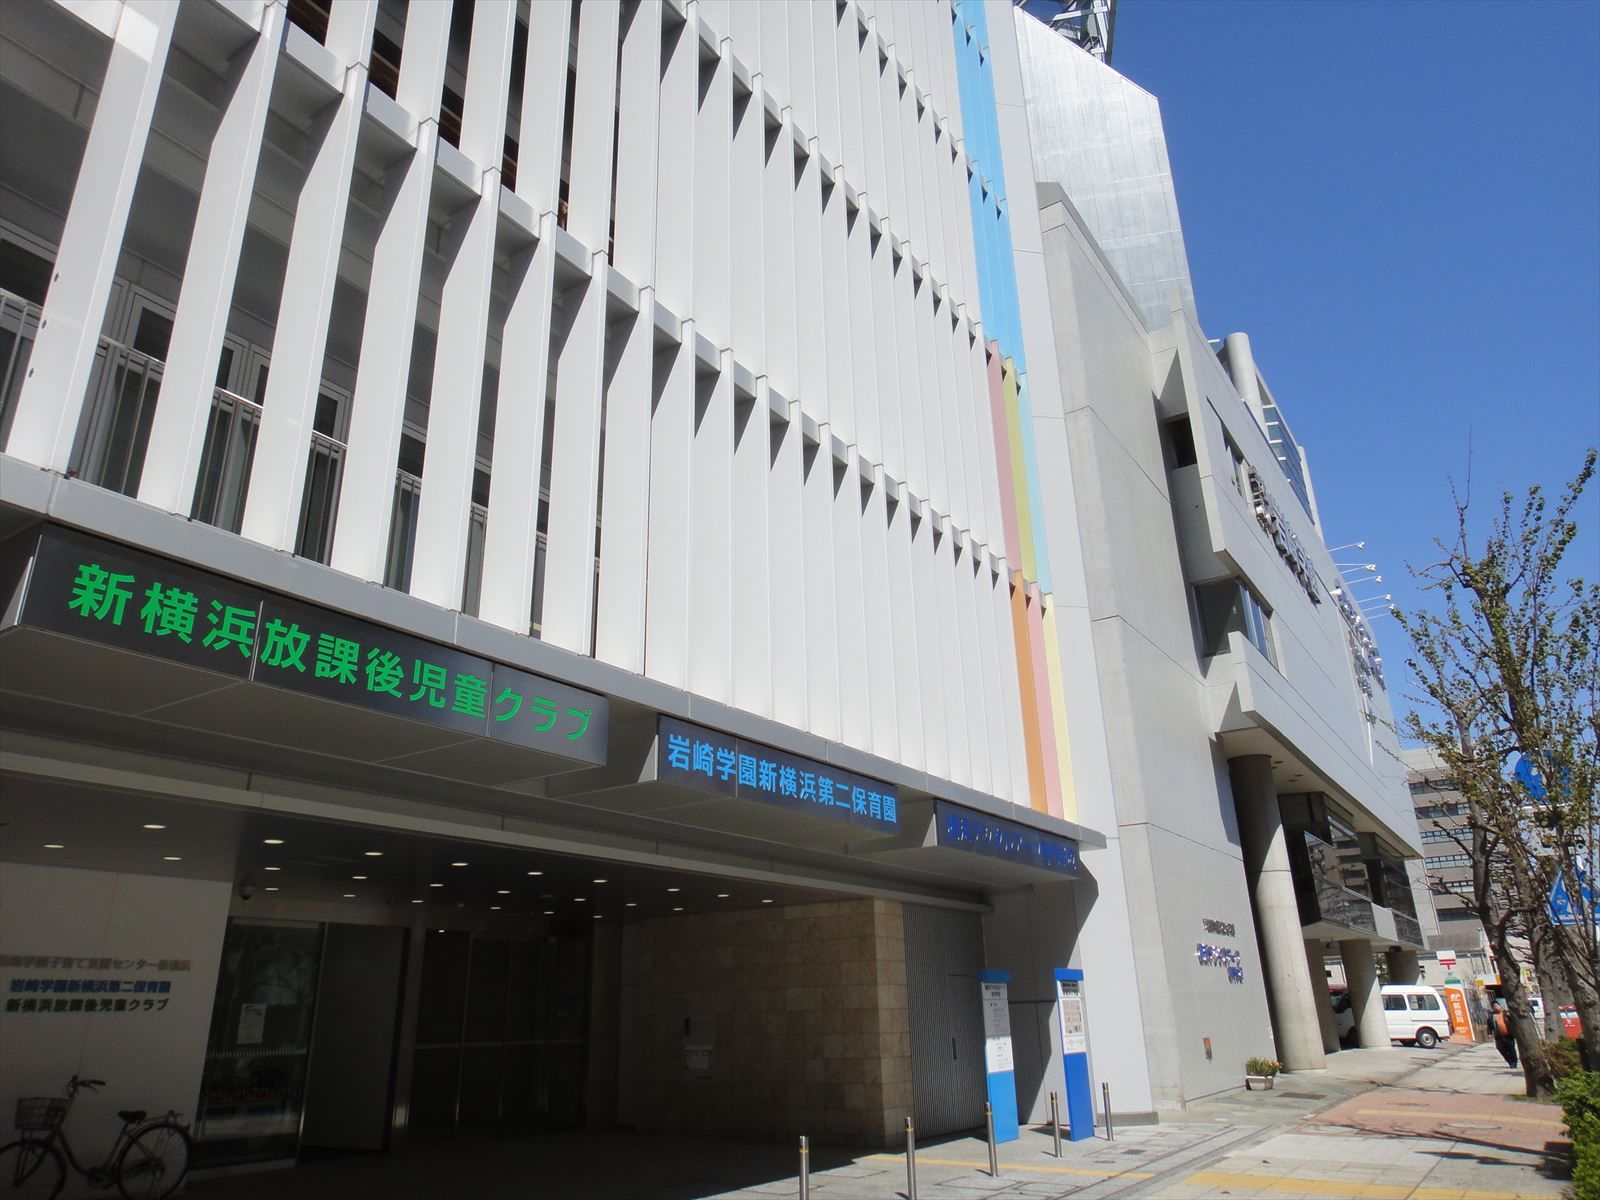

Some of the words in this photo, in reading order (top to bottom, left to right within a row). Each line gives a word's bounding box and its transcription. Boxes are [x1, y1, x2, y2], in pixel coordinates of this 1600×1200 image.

[68, 563, 592, 742] 新横浜放課後児童クラブ
[667, 734, 897, 824] 岩崎学園新横浜第二保育園
